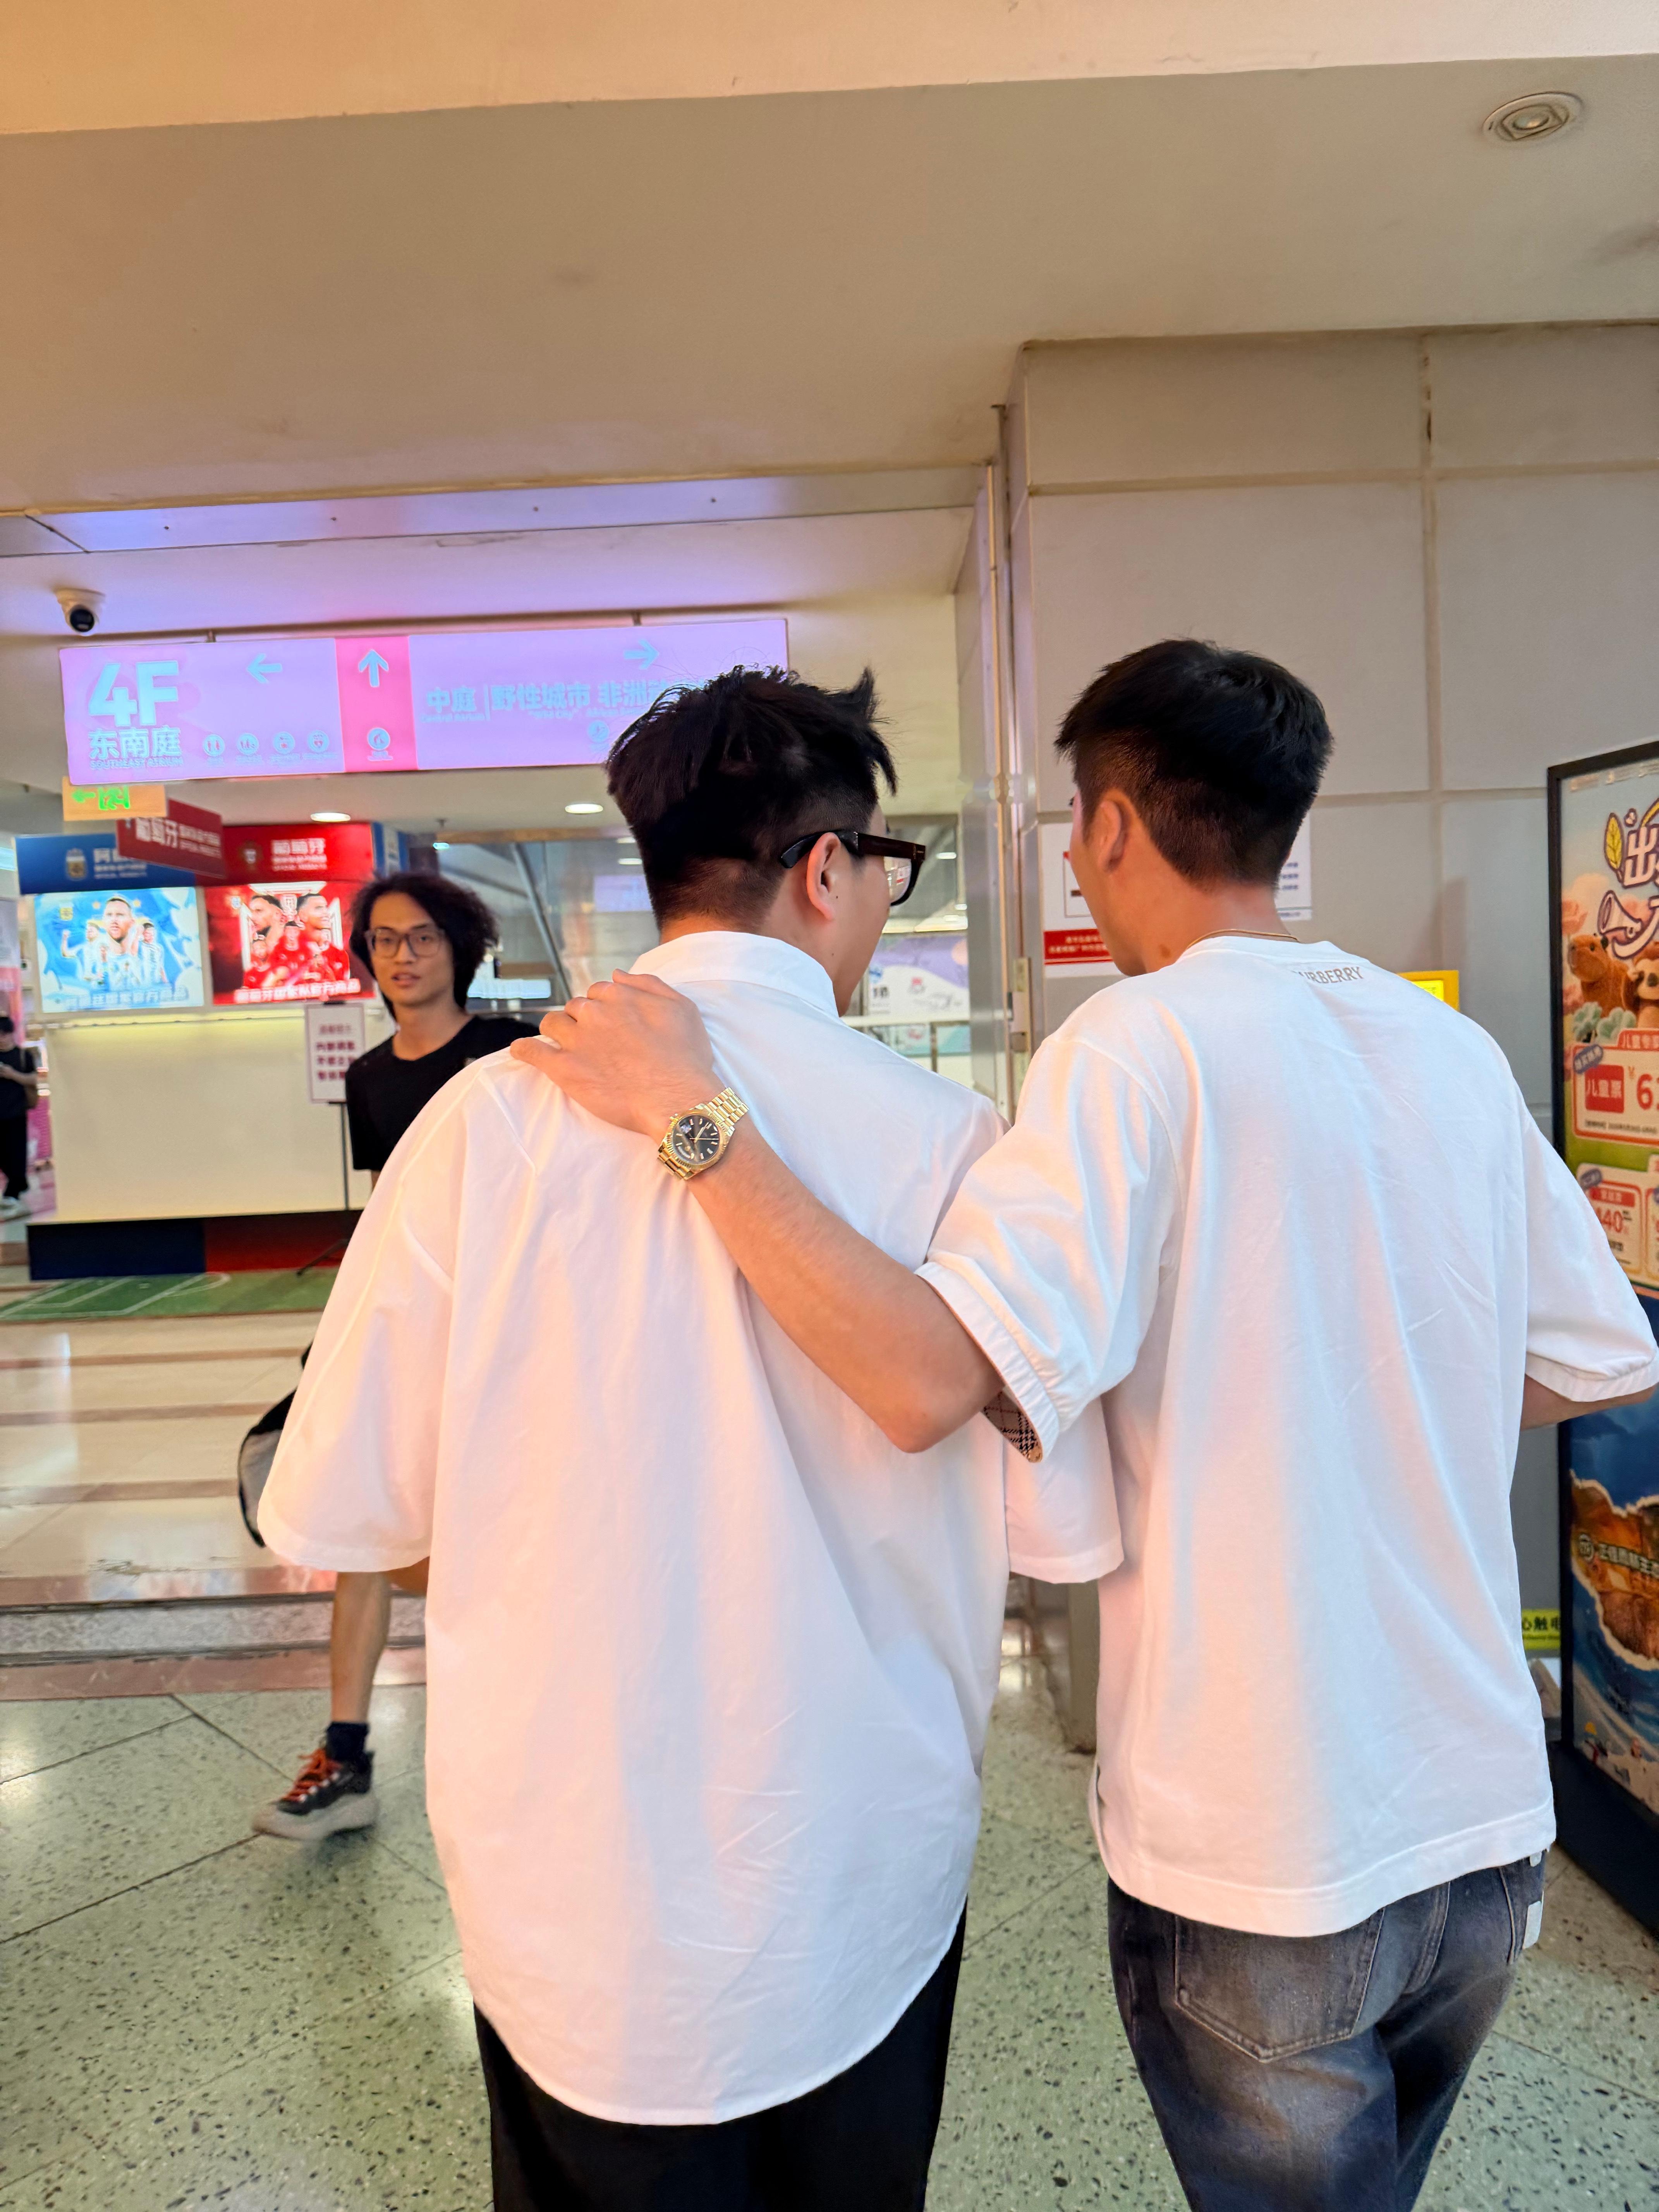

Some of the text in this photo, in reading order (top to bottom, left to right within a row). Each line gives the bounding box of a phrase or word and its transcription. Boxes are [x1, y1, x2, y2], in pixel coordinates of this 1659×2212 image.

[88, 660, 179, 726] 4F
[427, 685, 477, 713] 中庭
[491, 682, 590, 711] 野性城市
[88, 725, 182, 759] 东南庭
[1297, 967, 1364, 984] RBERRY
[1637, 1073, 1659, 1111] 6
